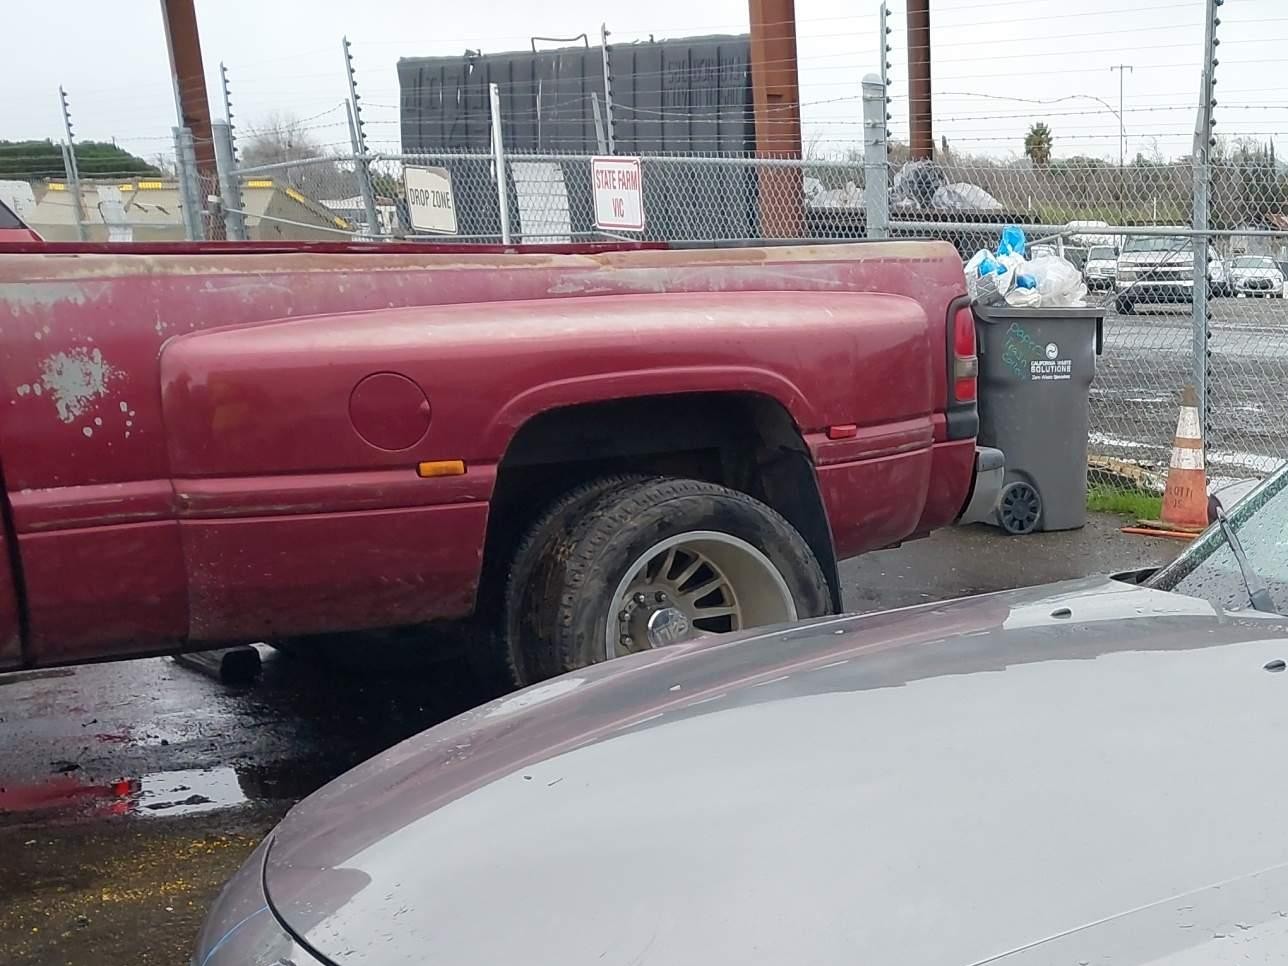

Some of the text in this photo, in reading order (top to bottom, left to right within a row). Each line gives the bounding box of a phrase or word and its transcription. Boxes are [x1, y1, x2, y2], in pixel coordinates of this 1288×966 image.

[596, 170, 637, 190] STATE FARM
[410, 188, 451, 208] DROP ZONE
[612, 198, 624, 217] VIC
